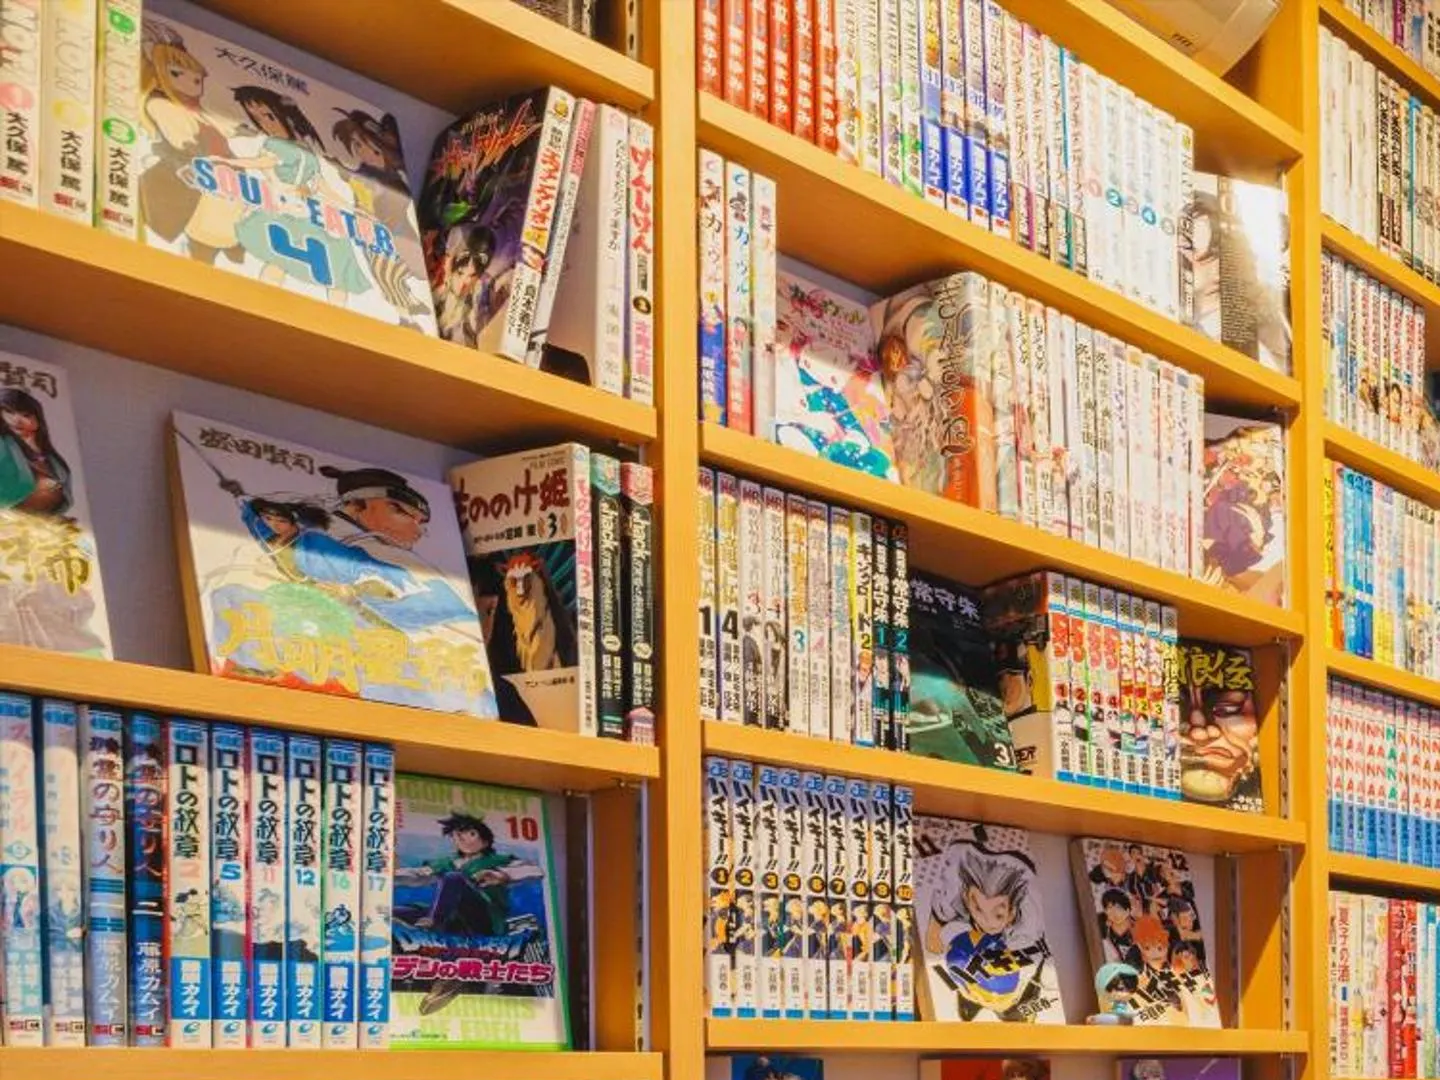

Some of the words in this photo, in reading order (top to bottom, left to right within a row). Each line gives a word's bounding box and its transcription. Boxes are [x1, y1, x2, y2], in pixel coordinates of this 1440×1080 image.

[267, 222, 333, 287] 4
[698, 604, 712, 636] 1
[721, 609, 739, 640] 4
[860, 632, 872, 650] 2
[895, 630, 907, 650] 2
[993, 743, 1011, 769] 3
[505, 815, 539, 841] 10
